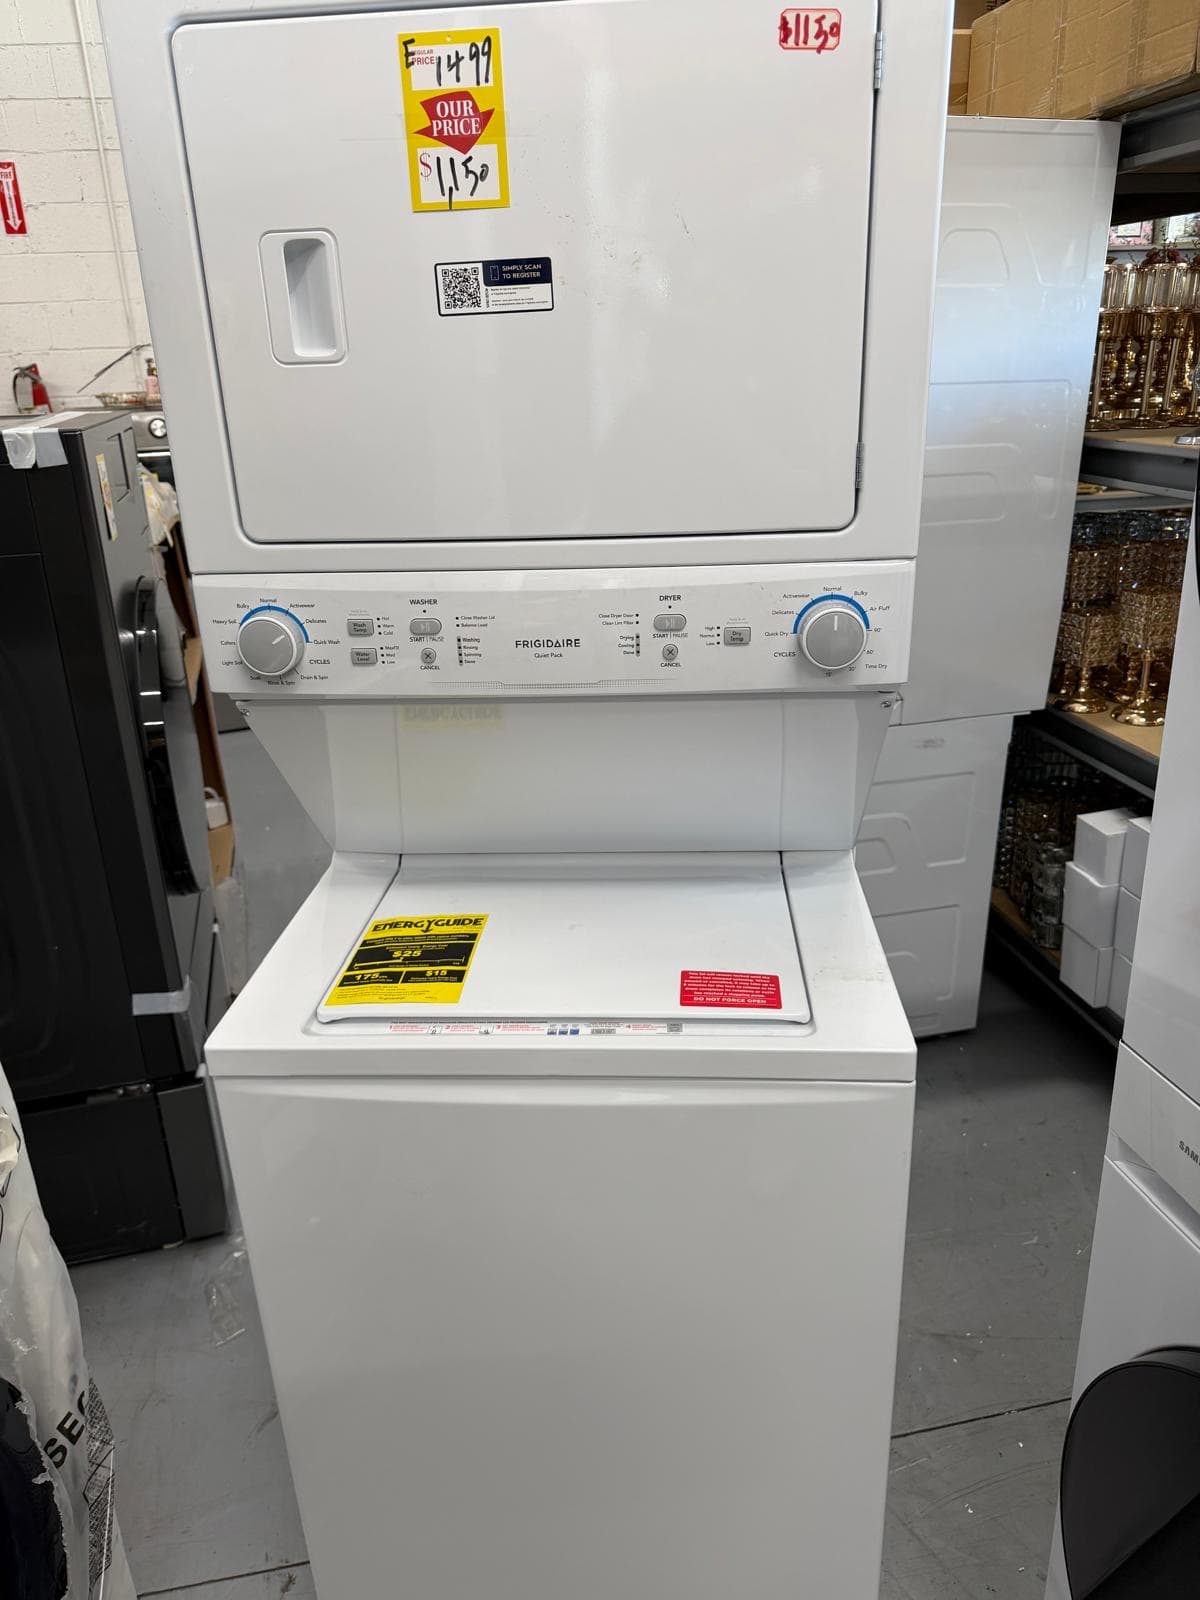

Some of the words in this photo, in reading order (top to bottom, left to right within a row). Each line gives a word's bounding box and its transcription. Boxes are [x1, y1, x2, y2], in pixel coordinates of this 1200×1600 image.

[412, 56, 434, 65] PRICE
[436, 35, 492, 86] 1499
[436, 100, 474, 118] OUR
[432, 117, 482, 137] PRICE
[515, 638, 581, 648] FRIGIDAIRE
[372, 917, 484, 932] ENERGYGUIDE
[1179, 1140, 1200, 1166] SAM
